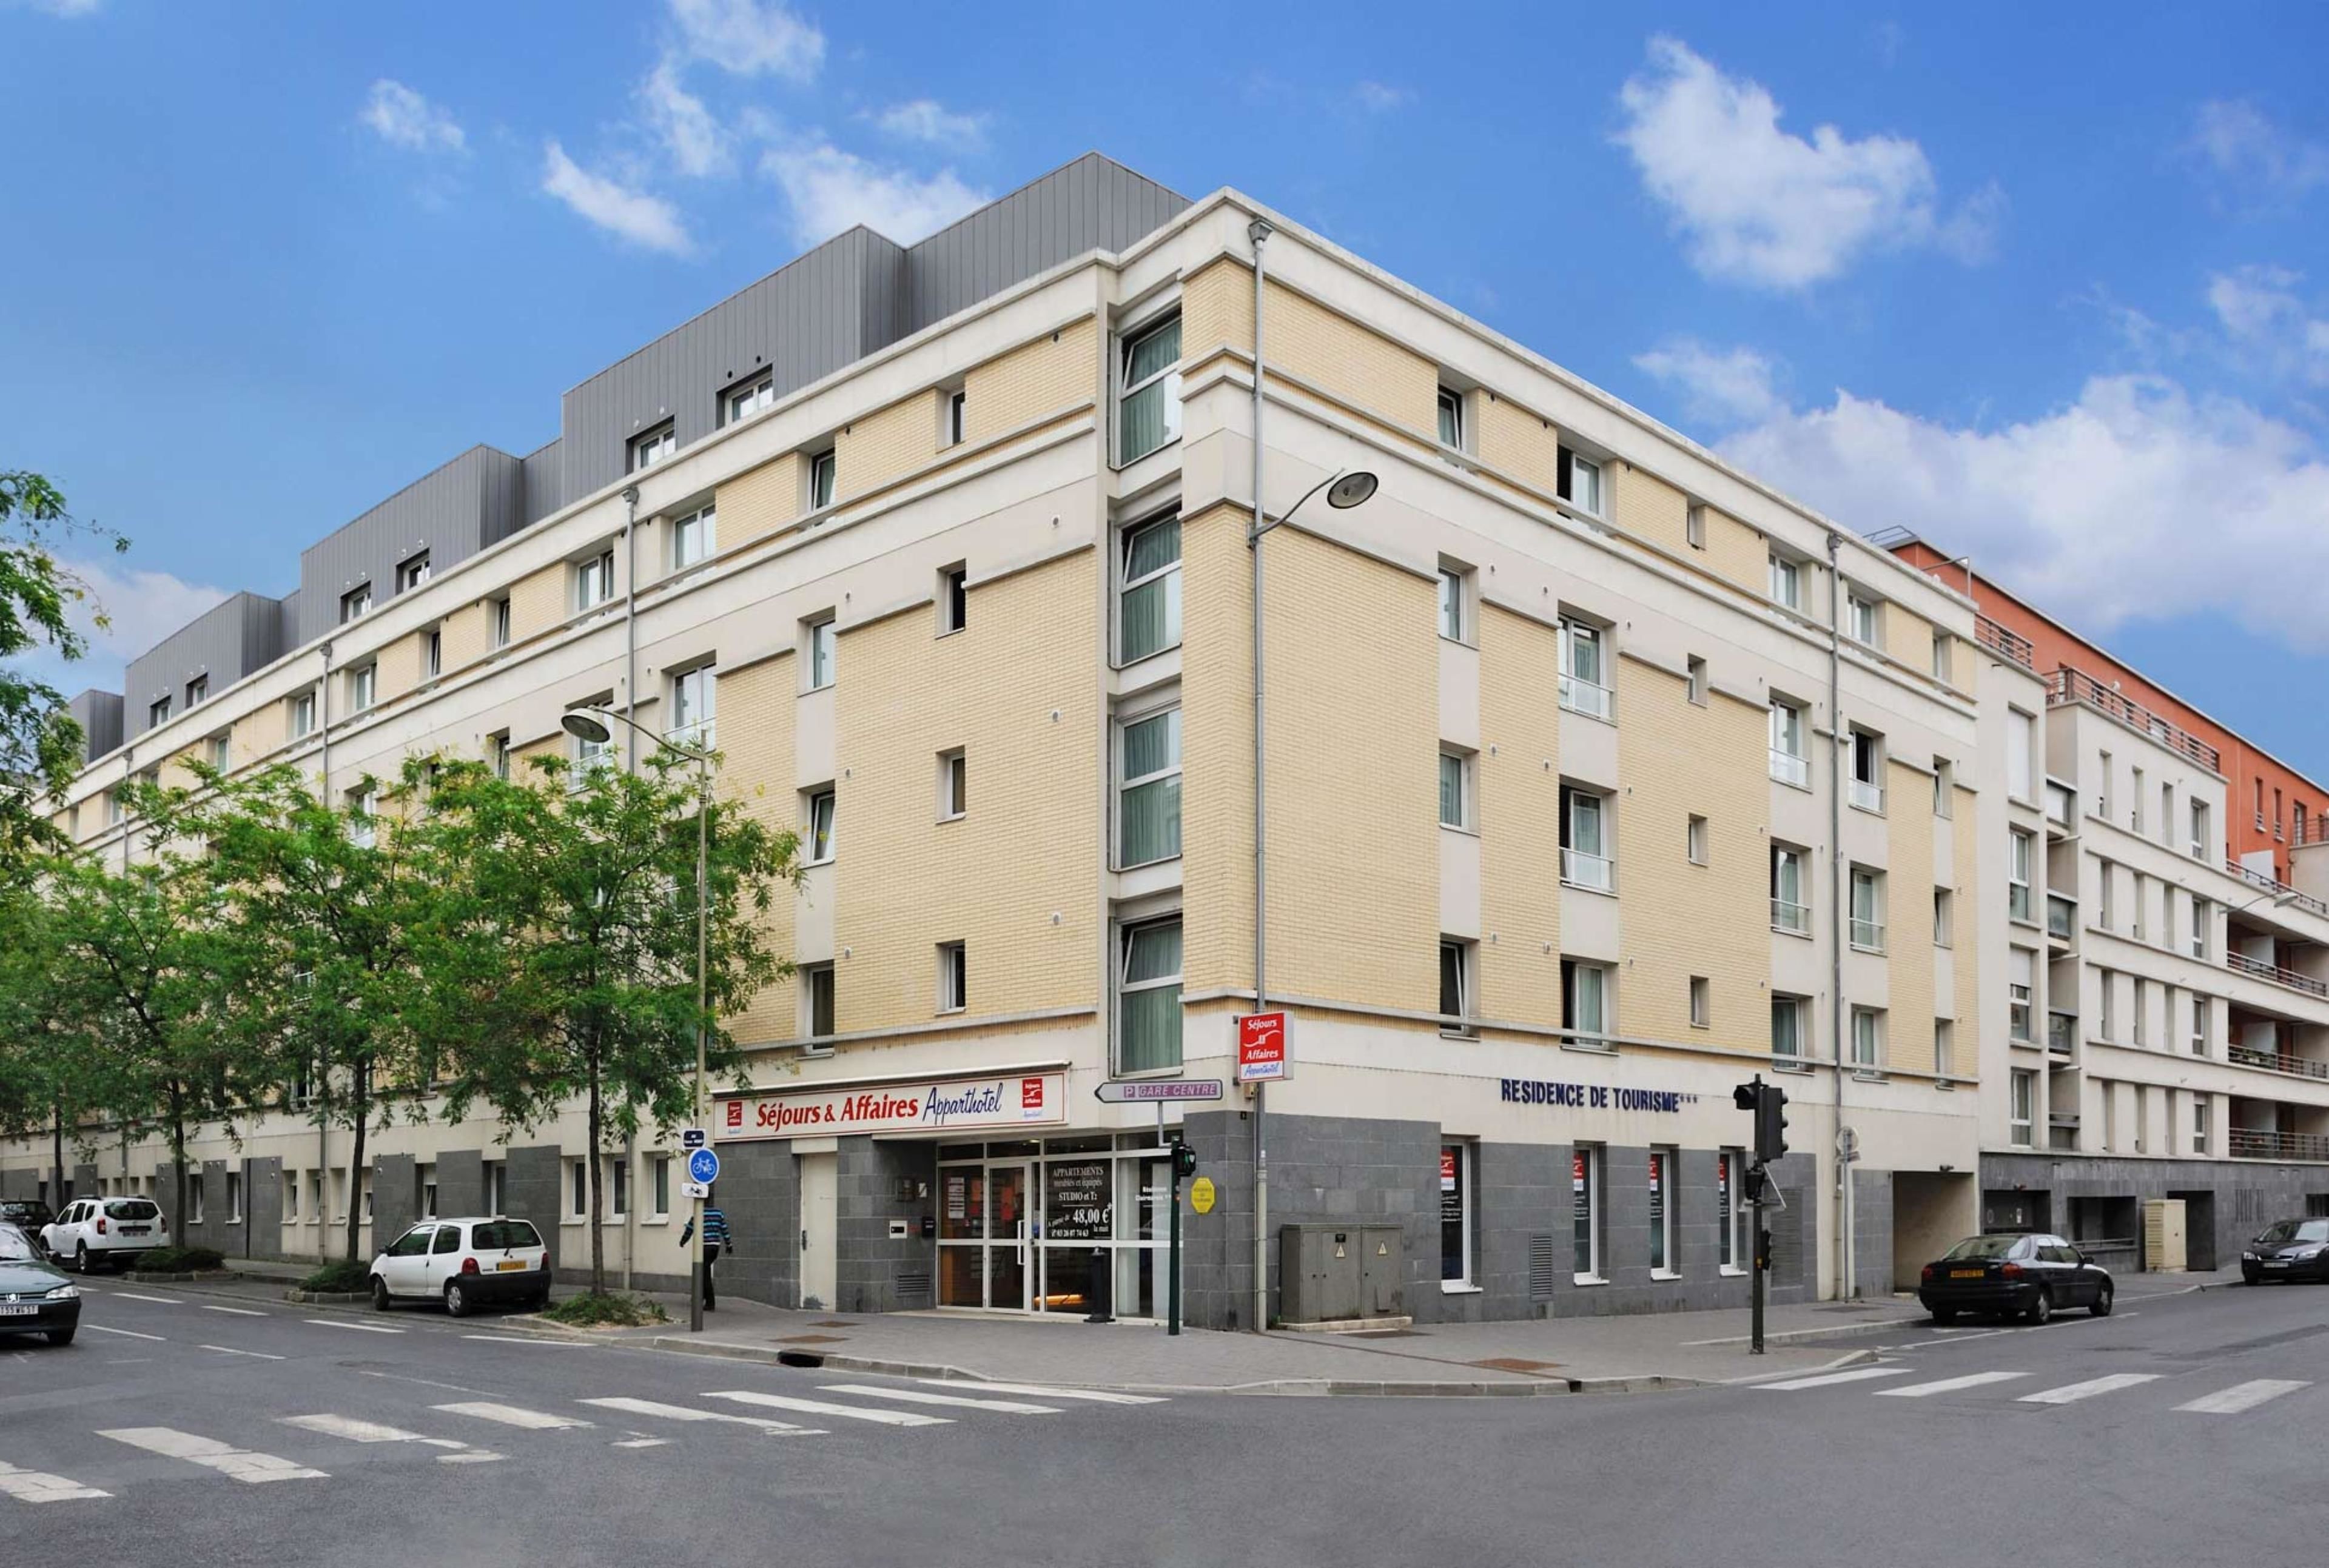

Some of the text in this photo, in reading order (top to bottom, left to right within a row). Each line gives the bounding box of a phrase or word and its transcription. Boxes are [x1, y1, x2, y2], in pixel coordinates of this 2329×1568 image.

[1247, 1019, 1277, 1031] Séjours
[1246, 1048, 1279, 1060] Affaires
[1125, 1083, 1217, 1097] P GARE CENTRE
[1501, 1078, 1585, 1107] RESIDENCE
[1590, 1085, 1608, 1108] DE
[757, 1102, 821, 1132] Séjours
[824, 1104, 836, 1122] &
[840, 1094, 918, 1122] Affaires
[1054, 1166, 1104, 1176] APPARTEMENTS
[1058, 1192, 1083, 1201] STUDIO
[1073, 1208, 1100, 1225] 48,00
[1102, 1208, 1110, 1224] €
